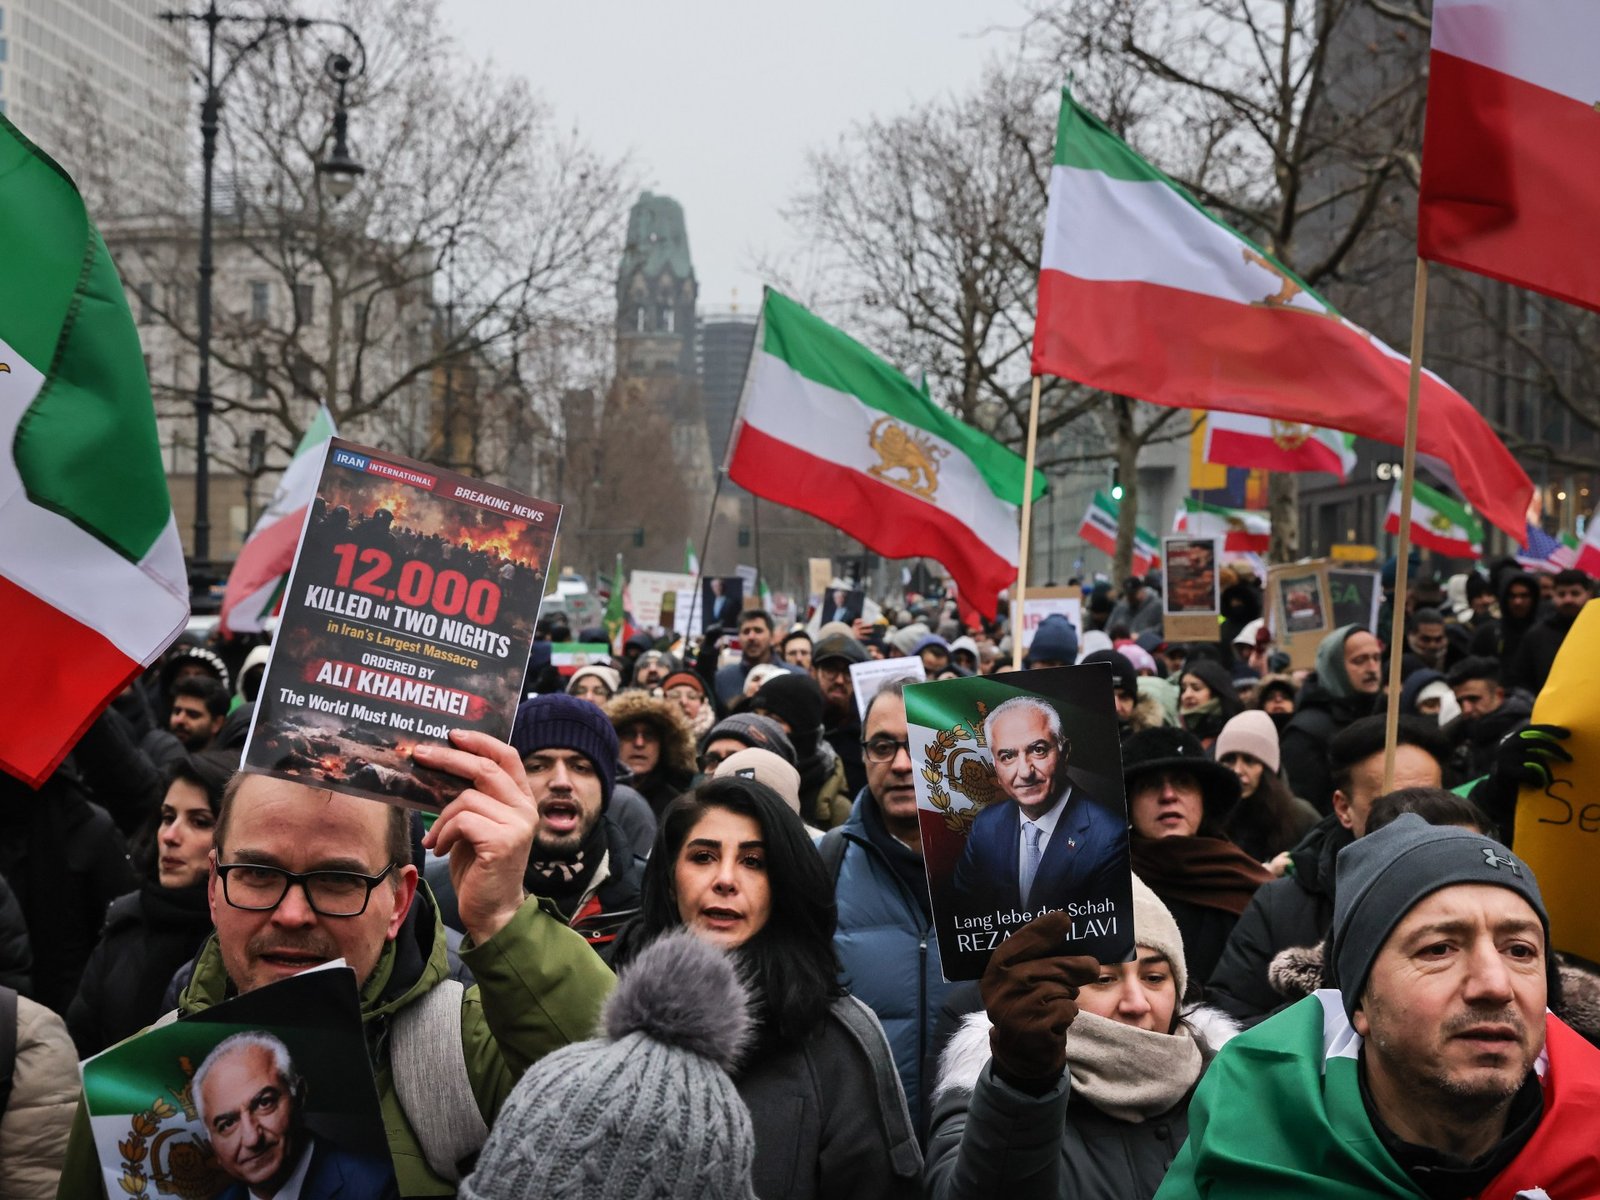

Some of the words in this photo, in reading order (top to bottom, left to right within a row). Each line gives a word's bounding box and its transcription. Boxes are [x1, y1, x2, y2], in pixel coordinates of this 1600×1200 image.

[336, 453, 365, 468] IRAN
[368, 462, 432, 487] INTERNATIONAL
[454, 486, 511, 511] BREAKING
[511, 503, 545, 522] NEWS
[333, 543, 502, 626] 12,000
[304, 584, 373, 620] KILLED
[374, 604, 391, 621] IN
[393, 605, 438, 637] TWO
[439, 618, 511, 659] NIGHTS
[326, 620, 339, 633] in
[376, 631, 422, 656] Largest
[423, 645, 479, 670] Massacre
[316, 661, 353, 689] ALI
[356, 669, 469, 717] KHAMENEI
[361, 652, 416, 677] ORDERED
[418, 666, 436, 681] BY
[279, 688, 306, 707] The
[308, 693, 350, 717] World
[350, 703, 388, 725] Must
[388, 713, 415, 733] Not
[416, 720, 451, 741] Look
[954, 914, 993, 931] Lang
[996, 909, 1033, 926] lebe
[1067, 897, 1115, 917] Schah
